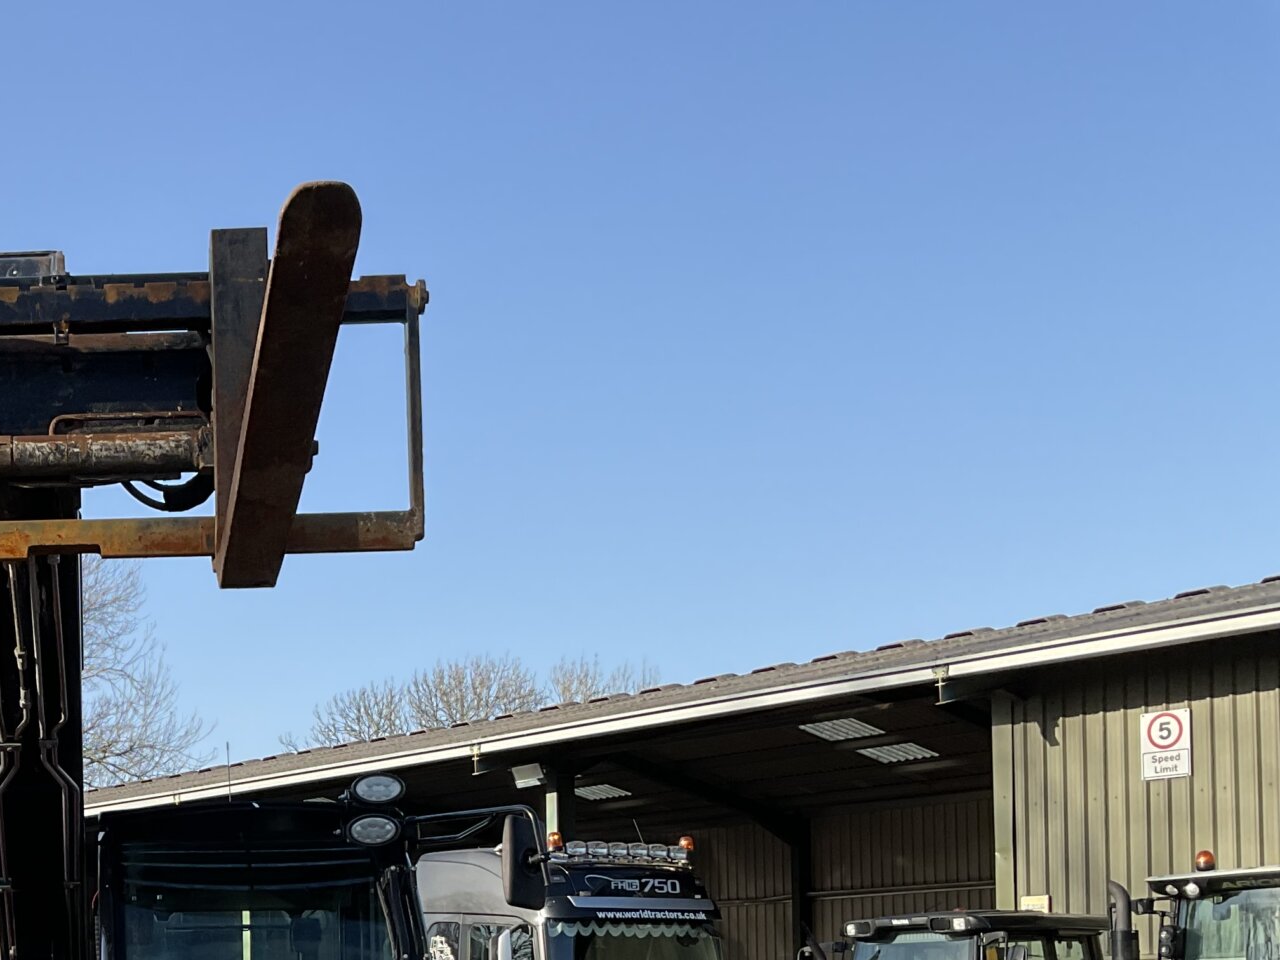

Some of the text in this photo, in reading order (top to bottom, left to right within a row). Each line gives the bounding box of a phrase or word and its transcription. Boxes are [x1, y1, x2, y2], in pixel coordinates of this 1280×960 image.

[1158, 722, 1172, 740] 5
[1151, 753, 1180, 763] Speed
[1154, 765, 1178, 774] Limit
[641, 879, 680, 893] 750
[597, 910, 707, 920] www.worldtractors.co.uk
